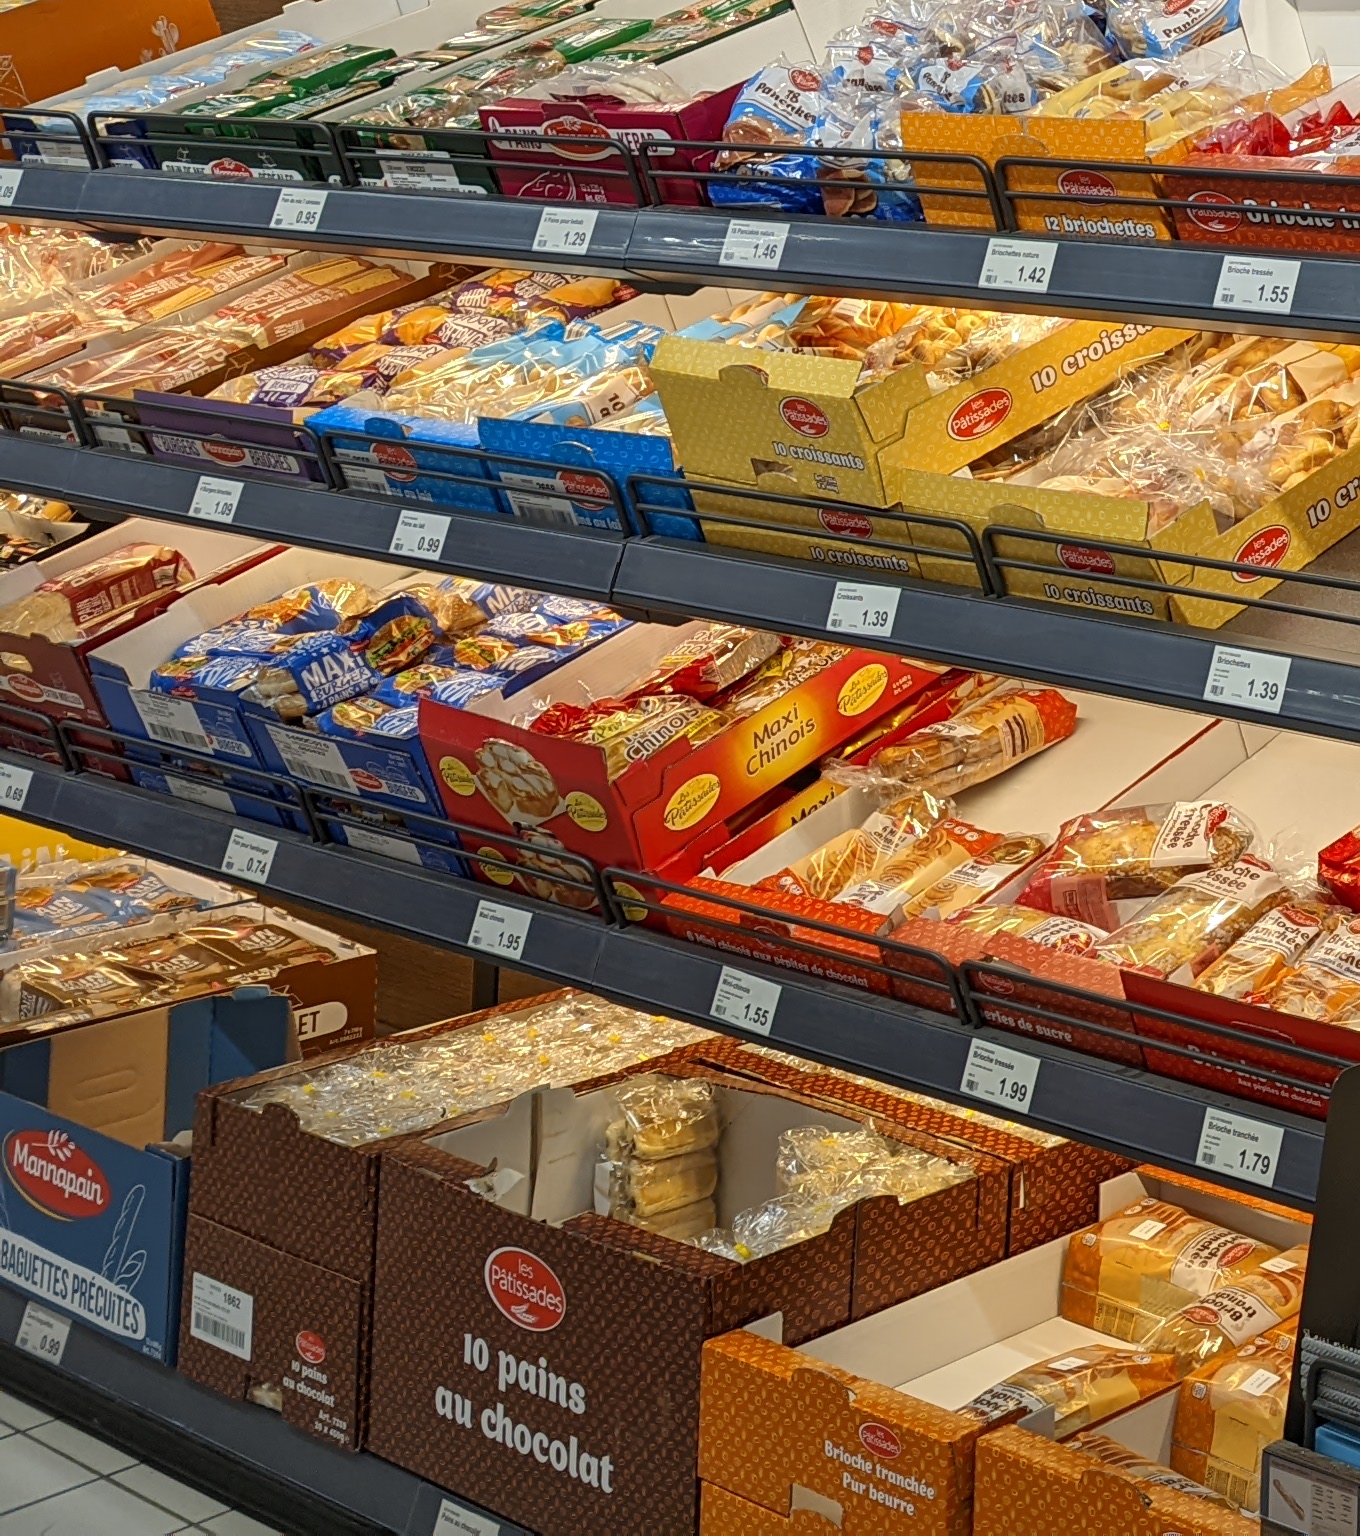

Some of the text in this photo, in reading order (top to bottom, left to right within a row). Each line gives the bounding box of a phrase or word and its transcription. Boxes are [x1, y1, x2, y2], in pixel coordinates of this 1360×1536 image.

[786, 89, 799, 104] 18
[1062, 181, 1116, 197] Pâtissades
[296, 210, 318, 226] 0.95
[1044, 215, 1156, 238] 12 briochettes
[563, 230, 586, 247] 1.29
[752, 242, 777, 260] 1.46
[991, 248, 1039, 260] Briochettes nature
[1017, 266, 1046, 284] 1.42
[1227, 265, 1274, 278] Brioche tressée
[1257, 284, 1290, 304] 1.55
[1030, 365, 1057, 394] 10
[951, 396, 1010, 432] Pâtissades
[970, 397, 985, 411] les
[783, 406, 827, 428] Pâtissades
[772, 441, 864, 471] 10 croissants
[214, 500, 233, 516] 1.09
[1306, 498, 1331, 528] 10
[417, 536, 440, 553] 0.99
[1253, 536, 1266, 550] les
[809, 545, 909, 572] 10 croissants
[836, 592, 864, 603] Croissants
[1044, 583, 1154, 614] 10 croissants
[861, 608, 888, 628] 1.39
[1216, 656, 1251, 669] Briochettes
[312, 667, 371, 703] BURGER
[1247, 678, 1279, 701] 1.39
[625, 706, 700, 763] Chinois
[752, 702, 799, 750] Maxi
[745, 716, 817, 777] Chinois
[6, 784, 24, 802] 0.69
[246, 858, 266, 876] 0.74
[498, 930, 522, 951] 1.95
[774, 953, 810, 973] pépites
[811, 963, 824, 976] de
[825, 967, 868, 988] chocolat
[743, 1003, 770, 1026] 1.55
[982, 1008, 1073, 1043] erles de sucre
[973, 1050, 993, 1063] Brioche
[999, 1076, 1029, 1103] 1.99
[1207, 1120, 1260, 1143] Brioche tranchée
[13, 1139, 104, 1206] Mannapain
[1237, 1147, 1271, 1175] 1.79
[1, 1239, 68, 1301] BAGUETTES
[518, 1258, 534, 1279] les
[491, 1264, 563, 1314] Pâtissades
[40, 1334, 60, 1357] 0.99
[301, 1363, 328, 1385] pains
[463, 1332, 586, 1415] 10 pains
[282, 1376, 335, 1409] au chocolat
[435, 1385, 615, 1494] au chocolat
[862, 1430, 900, 1454] Pâtissades
[824, 1439, 935, 1500] Brioche tranchée
[843, 1472, 915, 1516] Pur beurre
